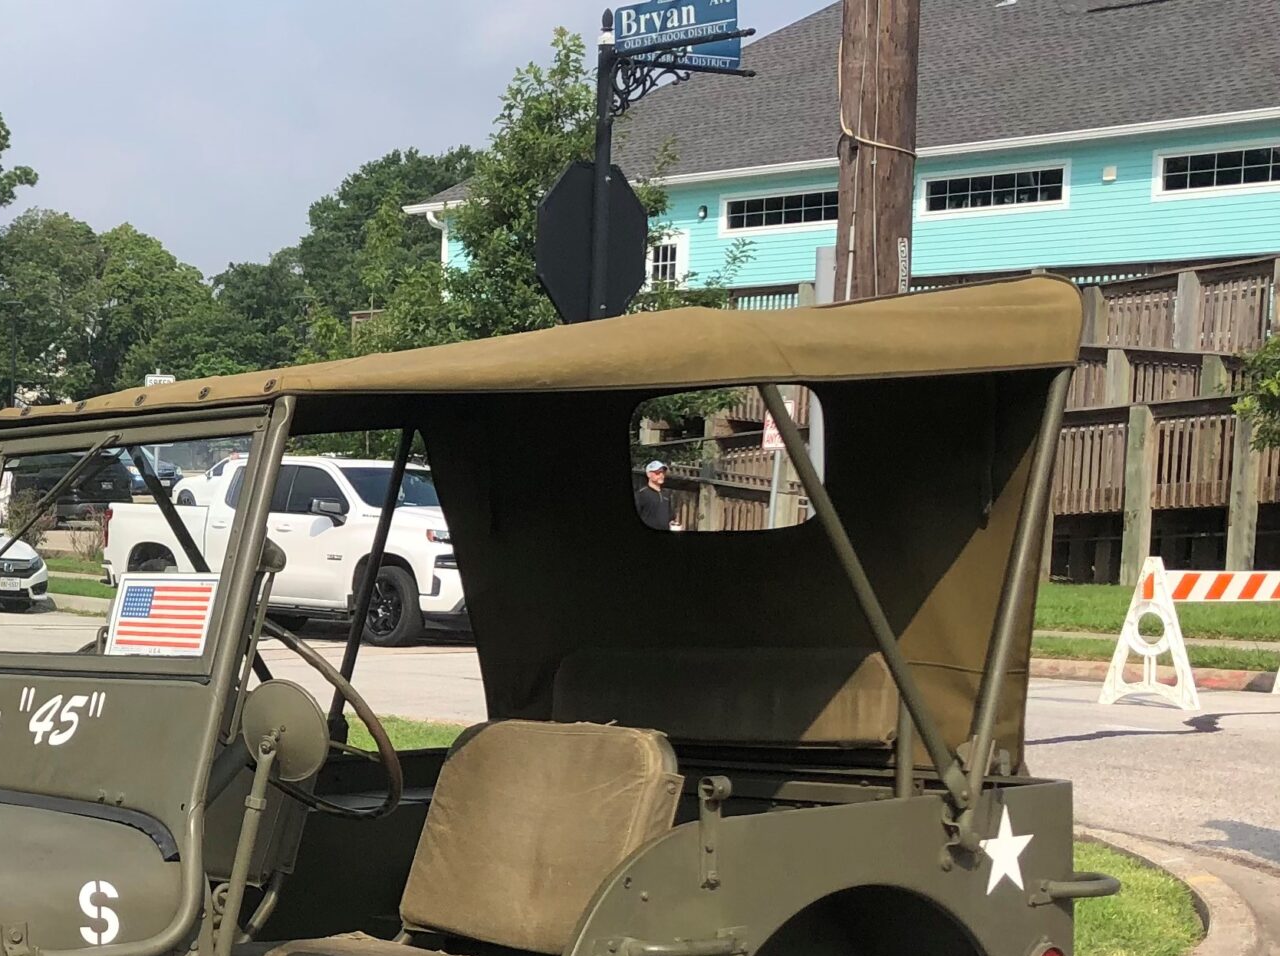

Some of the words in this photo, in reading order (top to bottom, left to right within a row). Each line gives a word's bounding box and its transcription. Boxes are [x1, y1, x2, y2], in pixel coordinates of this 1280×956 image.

[621, 5, 696, 38] Bryan
[624, 40, 642, 49] OLD
[644, 30, 686, 46] SEABROOK
[688, 23, 728, 39] DISTRICT
[692, 58, 730, 68] DISTRICT
[19, 687, 106, 746] "45"
[78, 880, 120, 945] S
